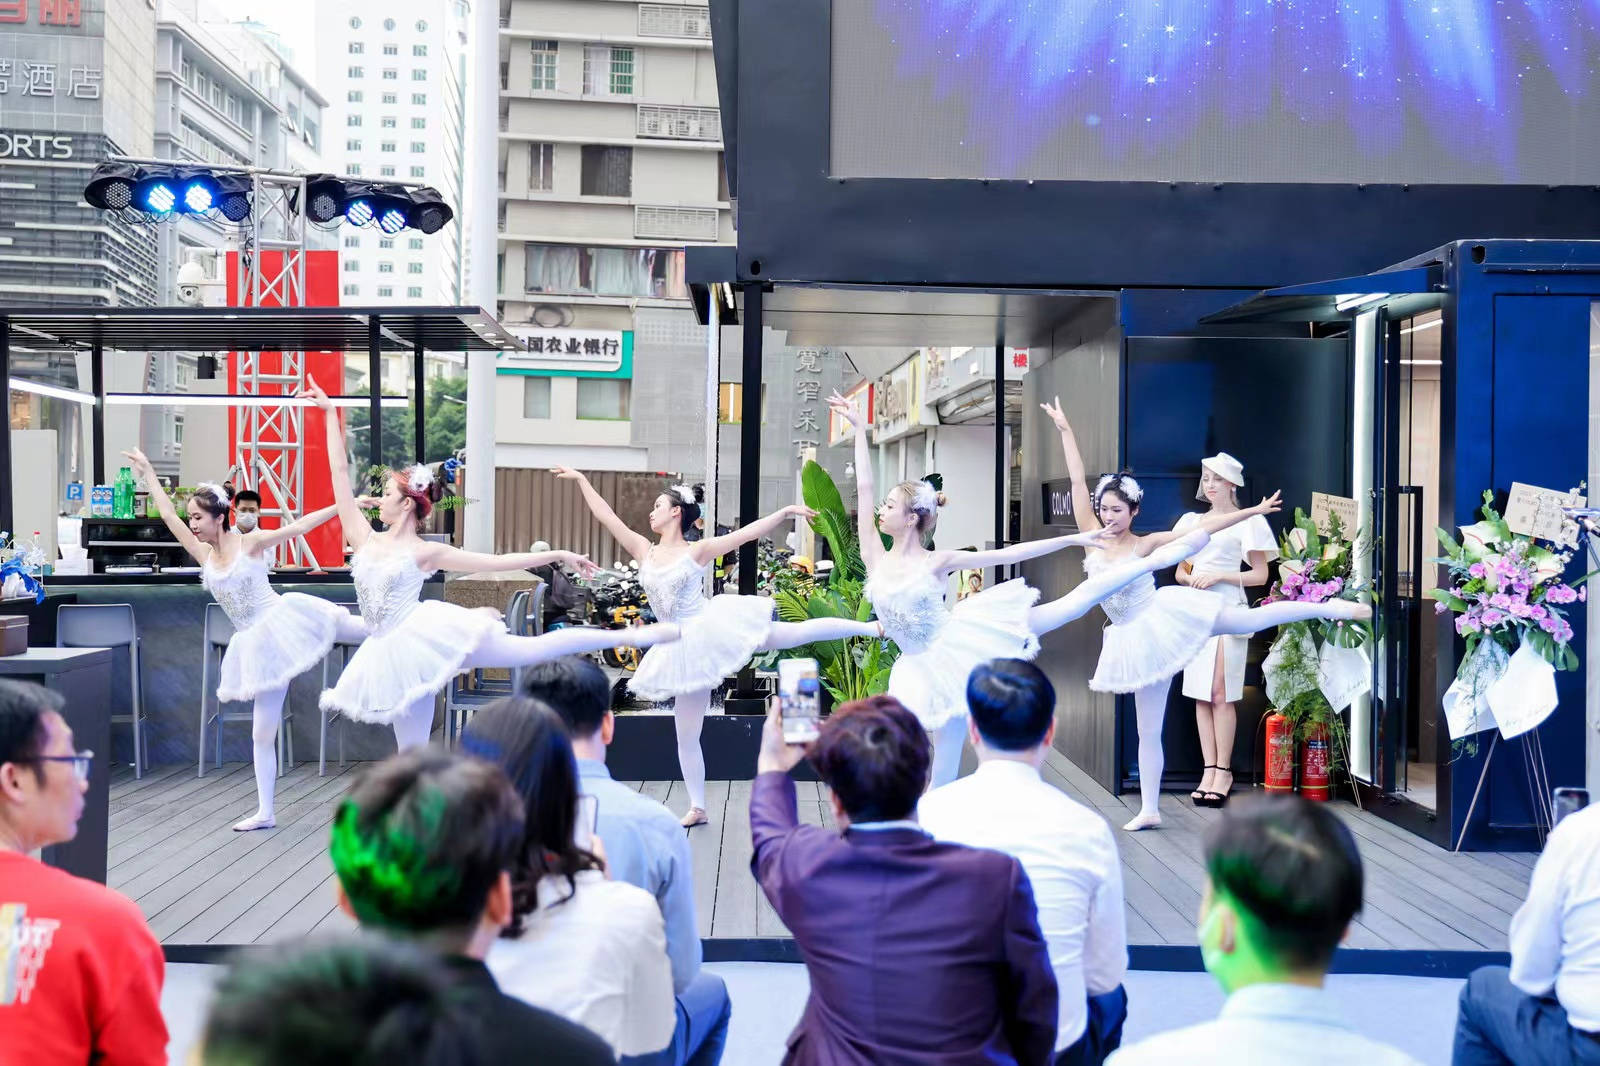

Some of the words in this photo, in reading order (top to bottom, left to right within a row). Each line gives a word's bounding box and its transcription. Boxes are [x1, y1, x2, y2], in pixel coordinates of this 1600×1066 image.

[514, 335, 620, 356] 国农业银行
